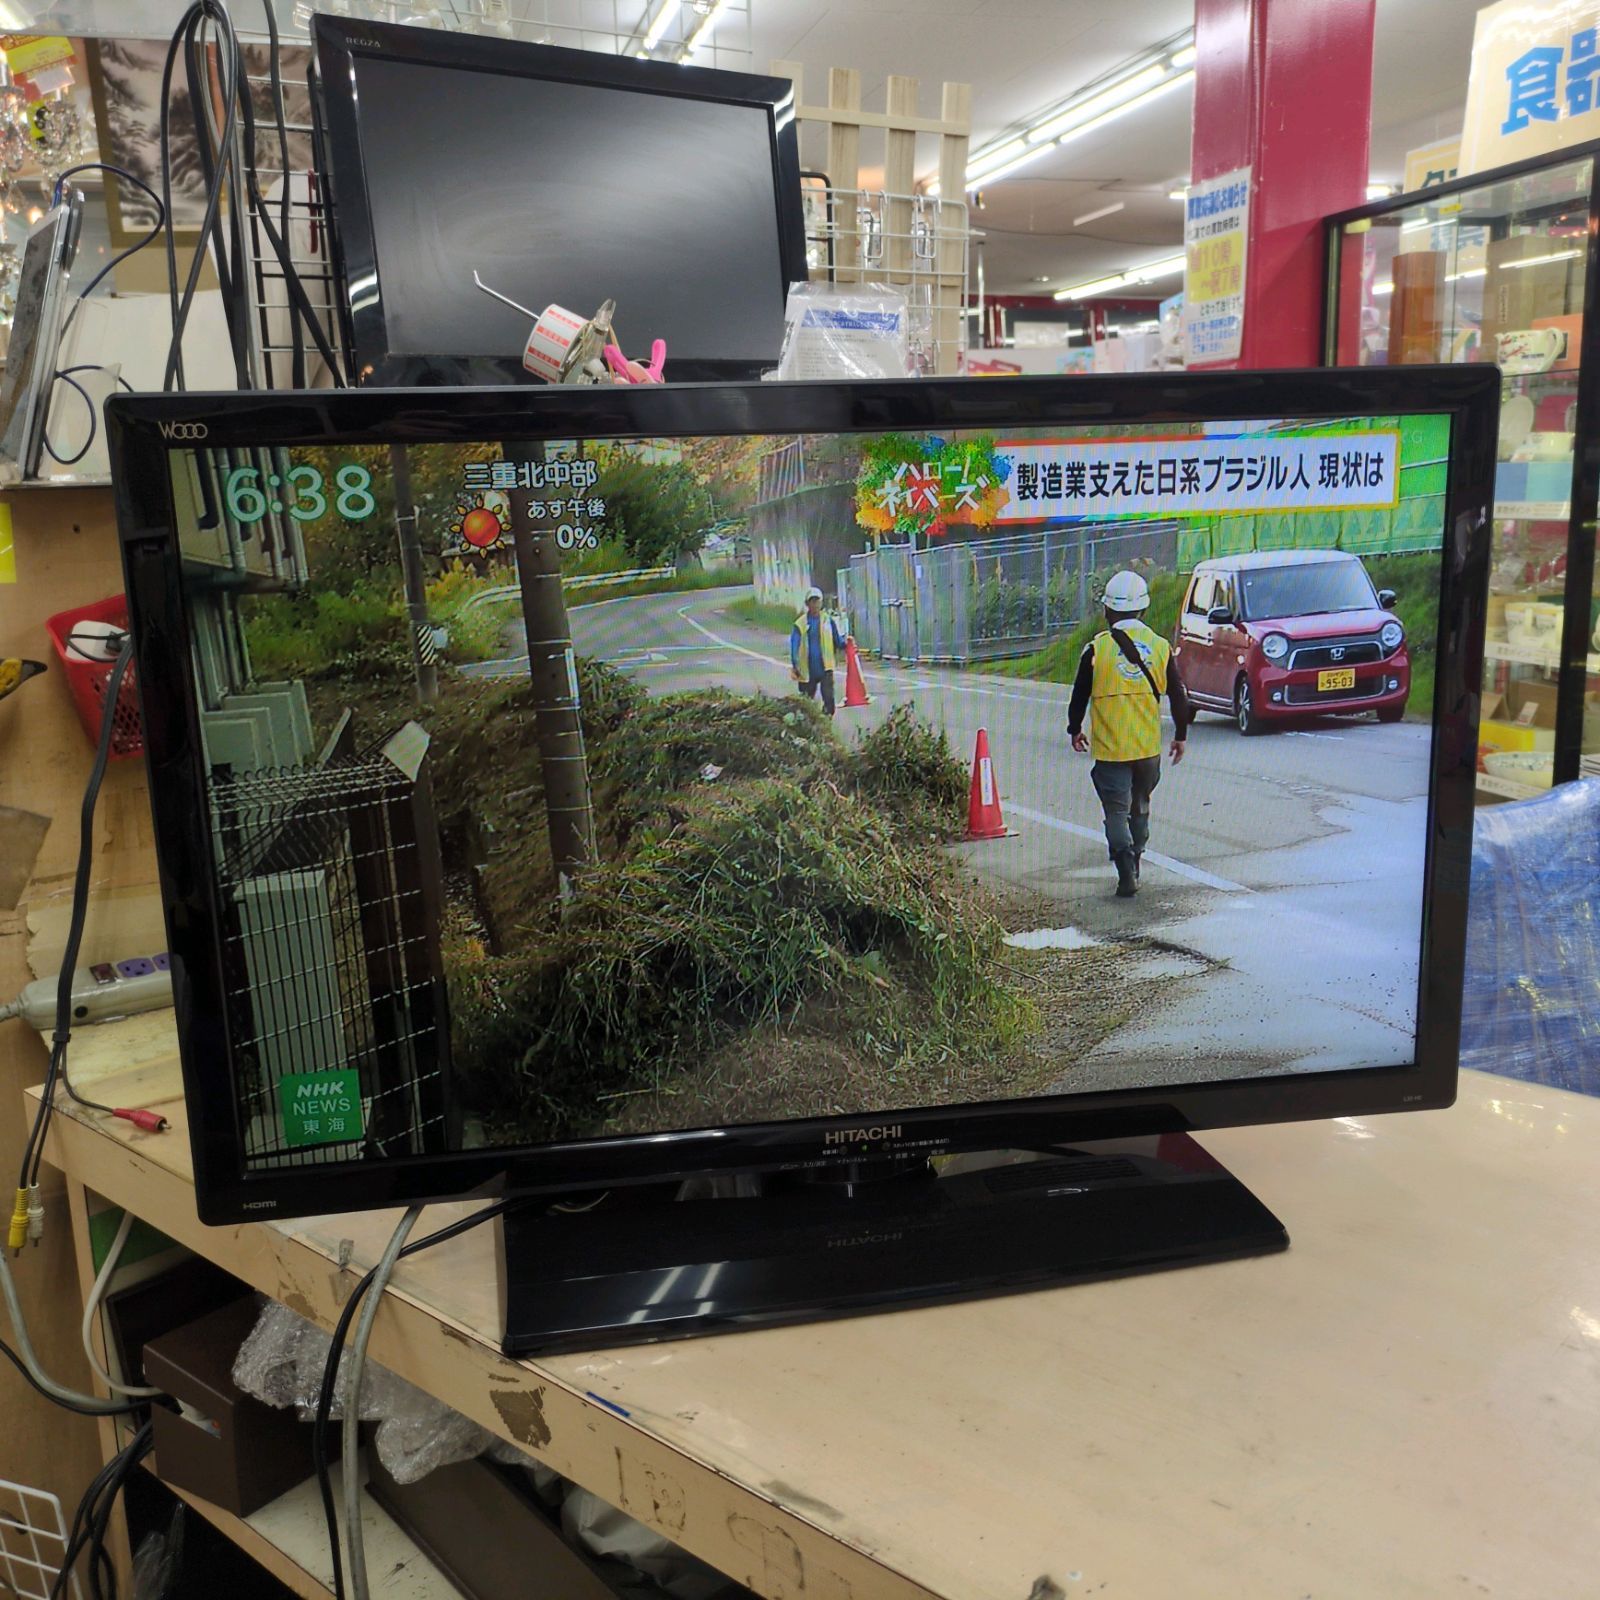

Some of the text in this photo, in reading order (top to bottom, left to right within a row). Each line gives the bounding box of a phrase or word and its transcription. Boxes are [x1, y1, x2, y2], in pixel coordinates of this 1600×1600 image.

[464, 460, 598, 490] 三重北中部
[1017, 451, 1384, 501] 製造業支えた日系ブラジル人 現状は
[225, 464, 376, 524] 6:38
[876, 474, 990, 517] ネイバーズ
[527, 497, 607, 520] あす午後
[555, 524, 599, 550] 0%
[1326, 676, 1353, 689] 95-03
[296, 1080, 345, 1099] NHK
[292, 1097, 351, 1116] NEWS
[303, 1117, 345, 1136] 東海
[825, 1125, 902, 1145] HITACHI
[242, 1200, 277, 1210] HDMI
